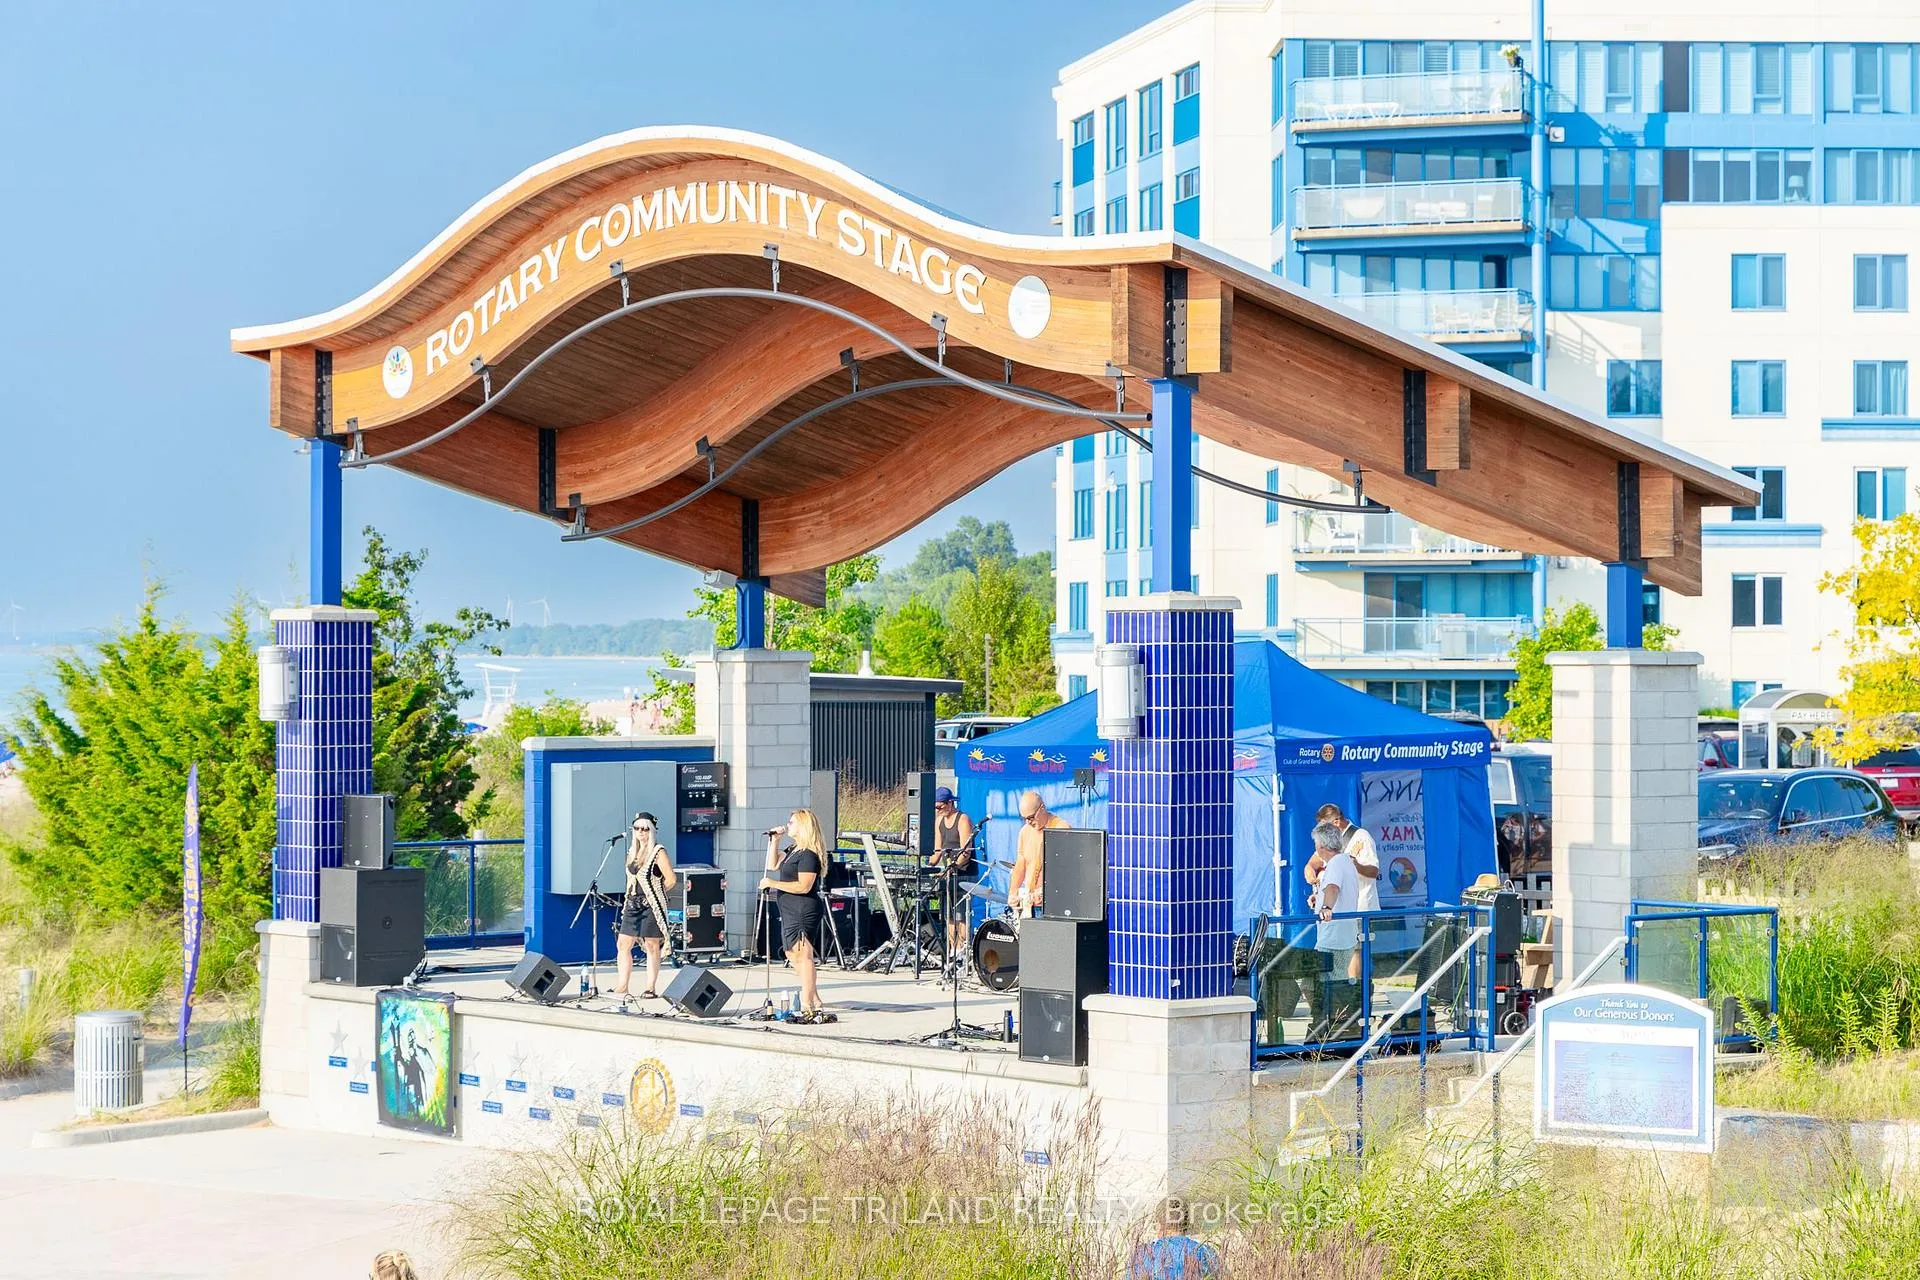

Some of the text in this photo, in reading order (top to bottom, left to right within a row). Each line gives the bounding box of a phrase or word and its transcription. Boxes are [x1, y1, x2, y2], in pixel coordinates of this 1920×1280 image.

[426, 180, 987, 376] ROTARY COMMUNITY STAGE
[1791, 711, 1833, 720] PAY HERE
[1299, 748, 1321, 758] Rotary
[1341, 740, 1484, 762] Rotary Community Stage
[1573, 1007, 1675, 1021] Our Generous Donors
